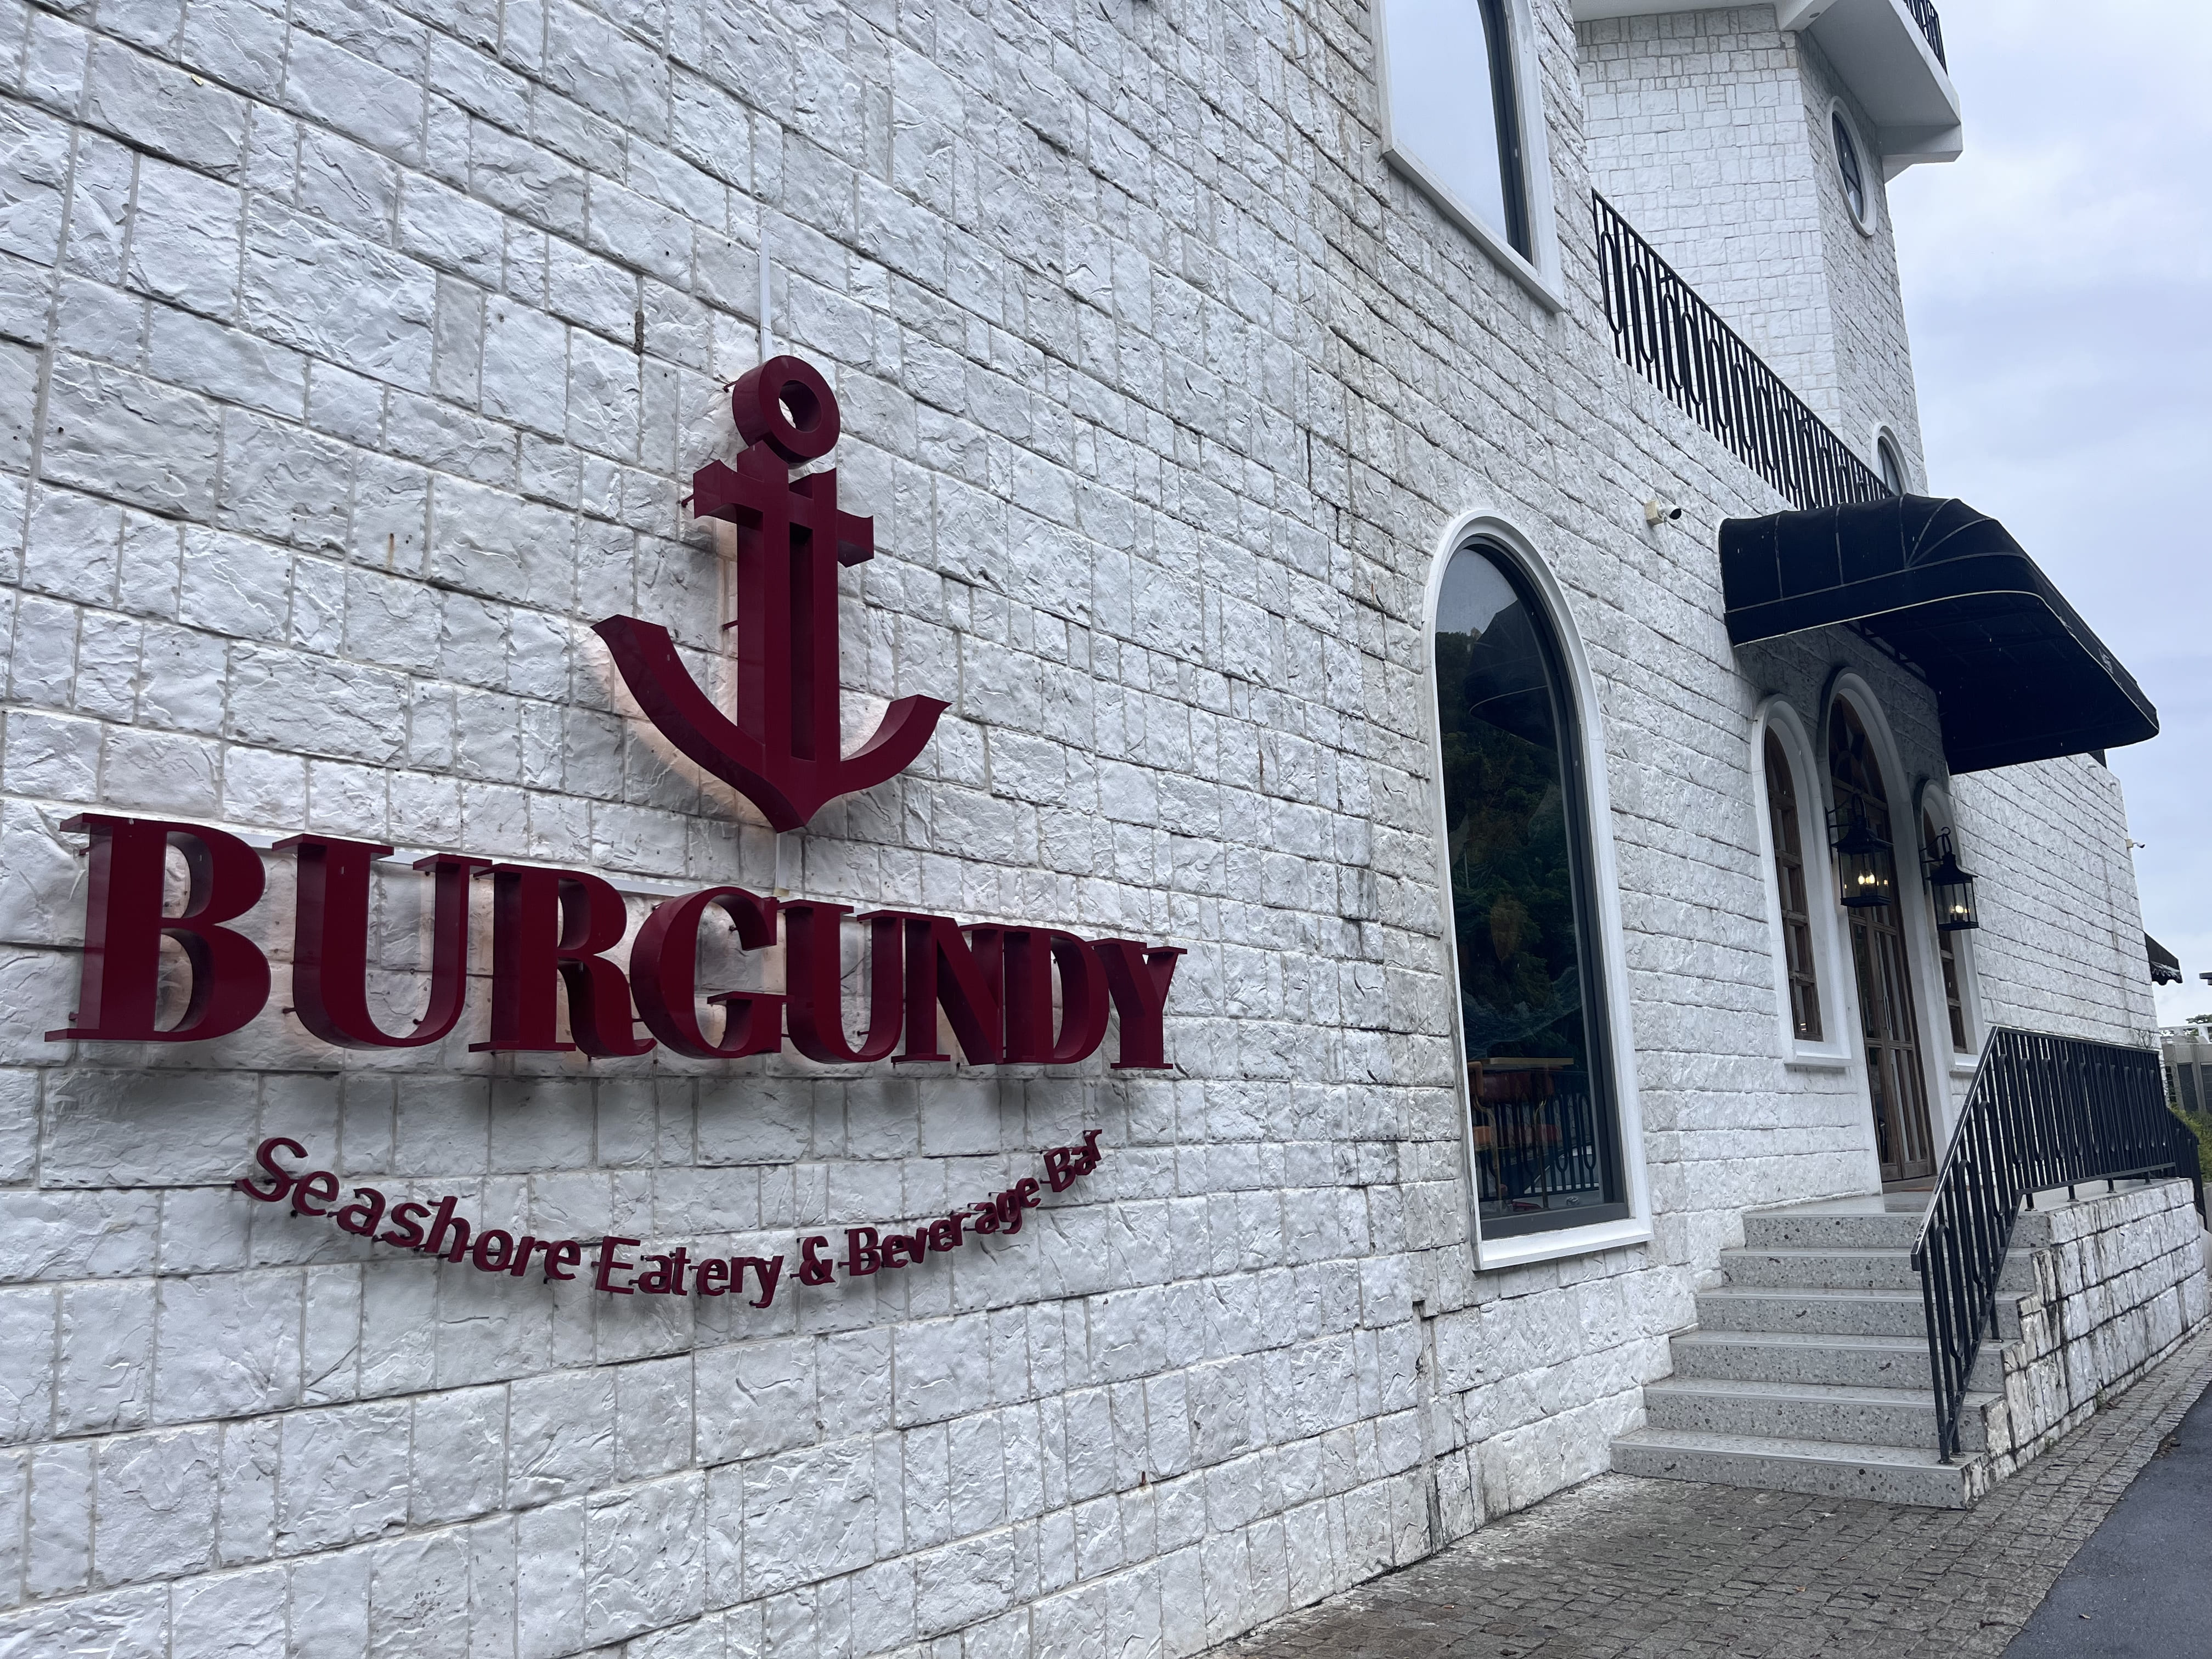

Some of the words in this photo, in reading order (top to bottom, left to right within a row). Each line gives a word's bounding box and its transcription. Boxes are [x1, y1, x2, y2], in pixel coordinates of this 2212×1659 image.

[44, 812, 1187, 1069] BURGUNDY
[236, 1137, 581, 1280] Seashore
[595, 1236, 783, 1308] Eatery
[799, 1235, 835, 1286] &
[848, 1177, 1041, 1276] Beverage
[1043, 1129, 1103, 1193] Bar
